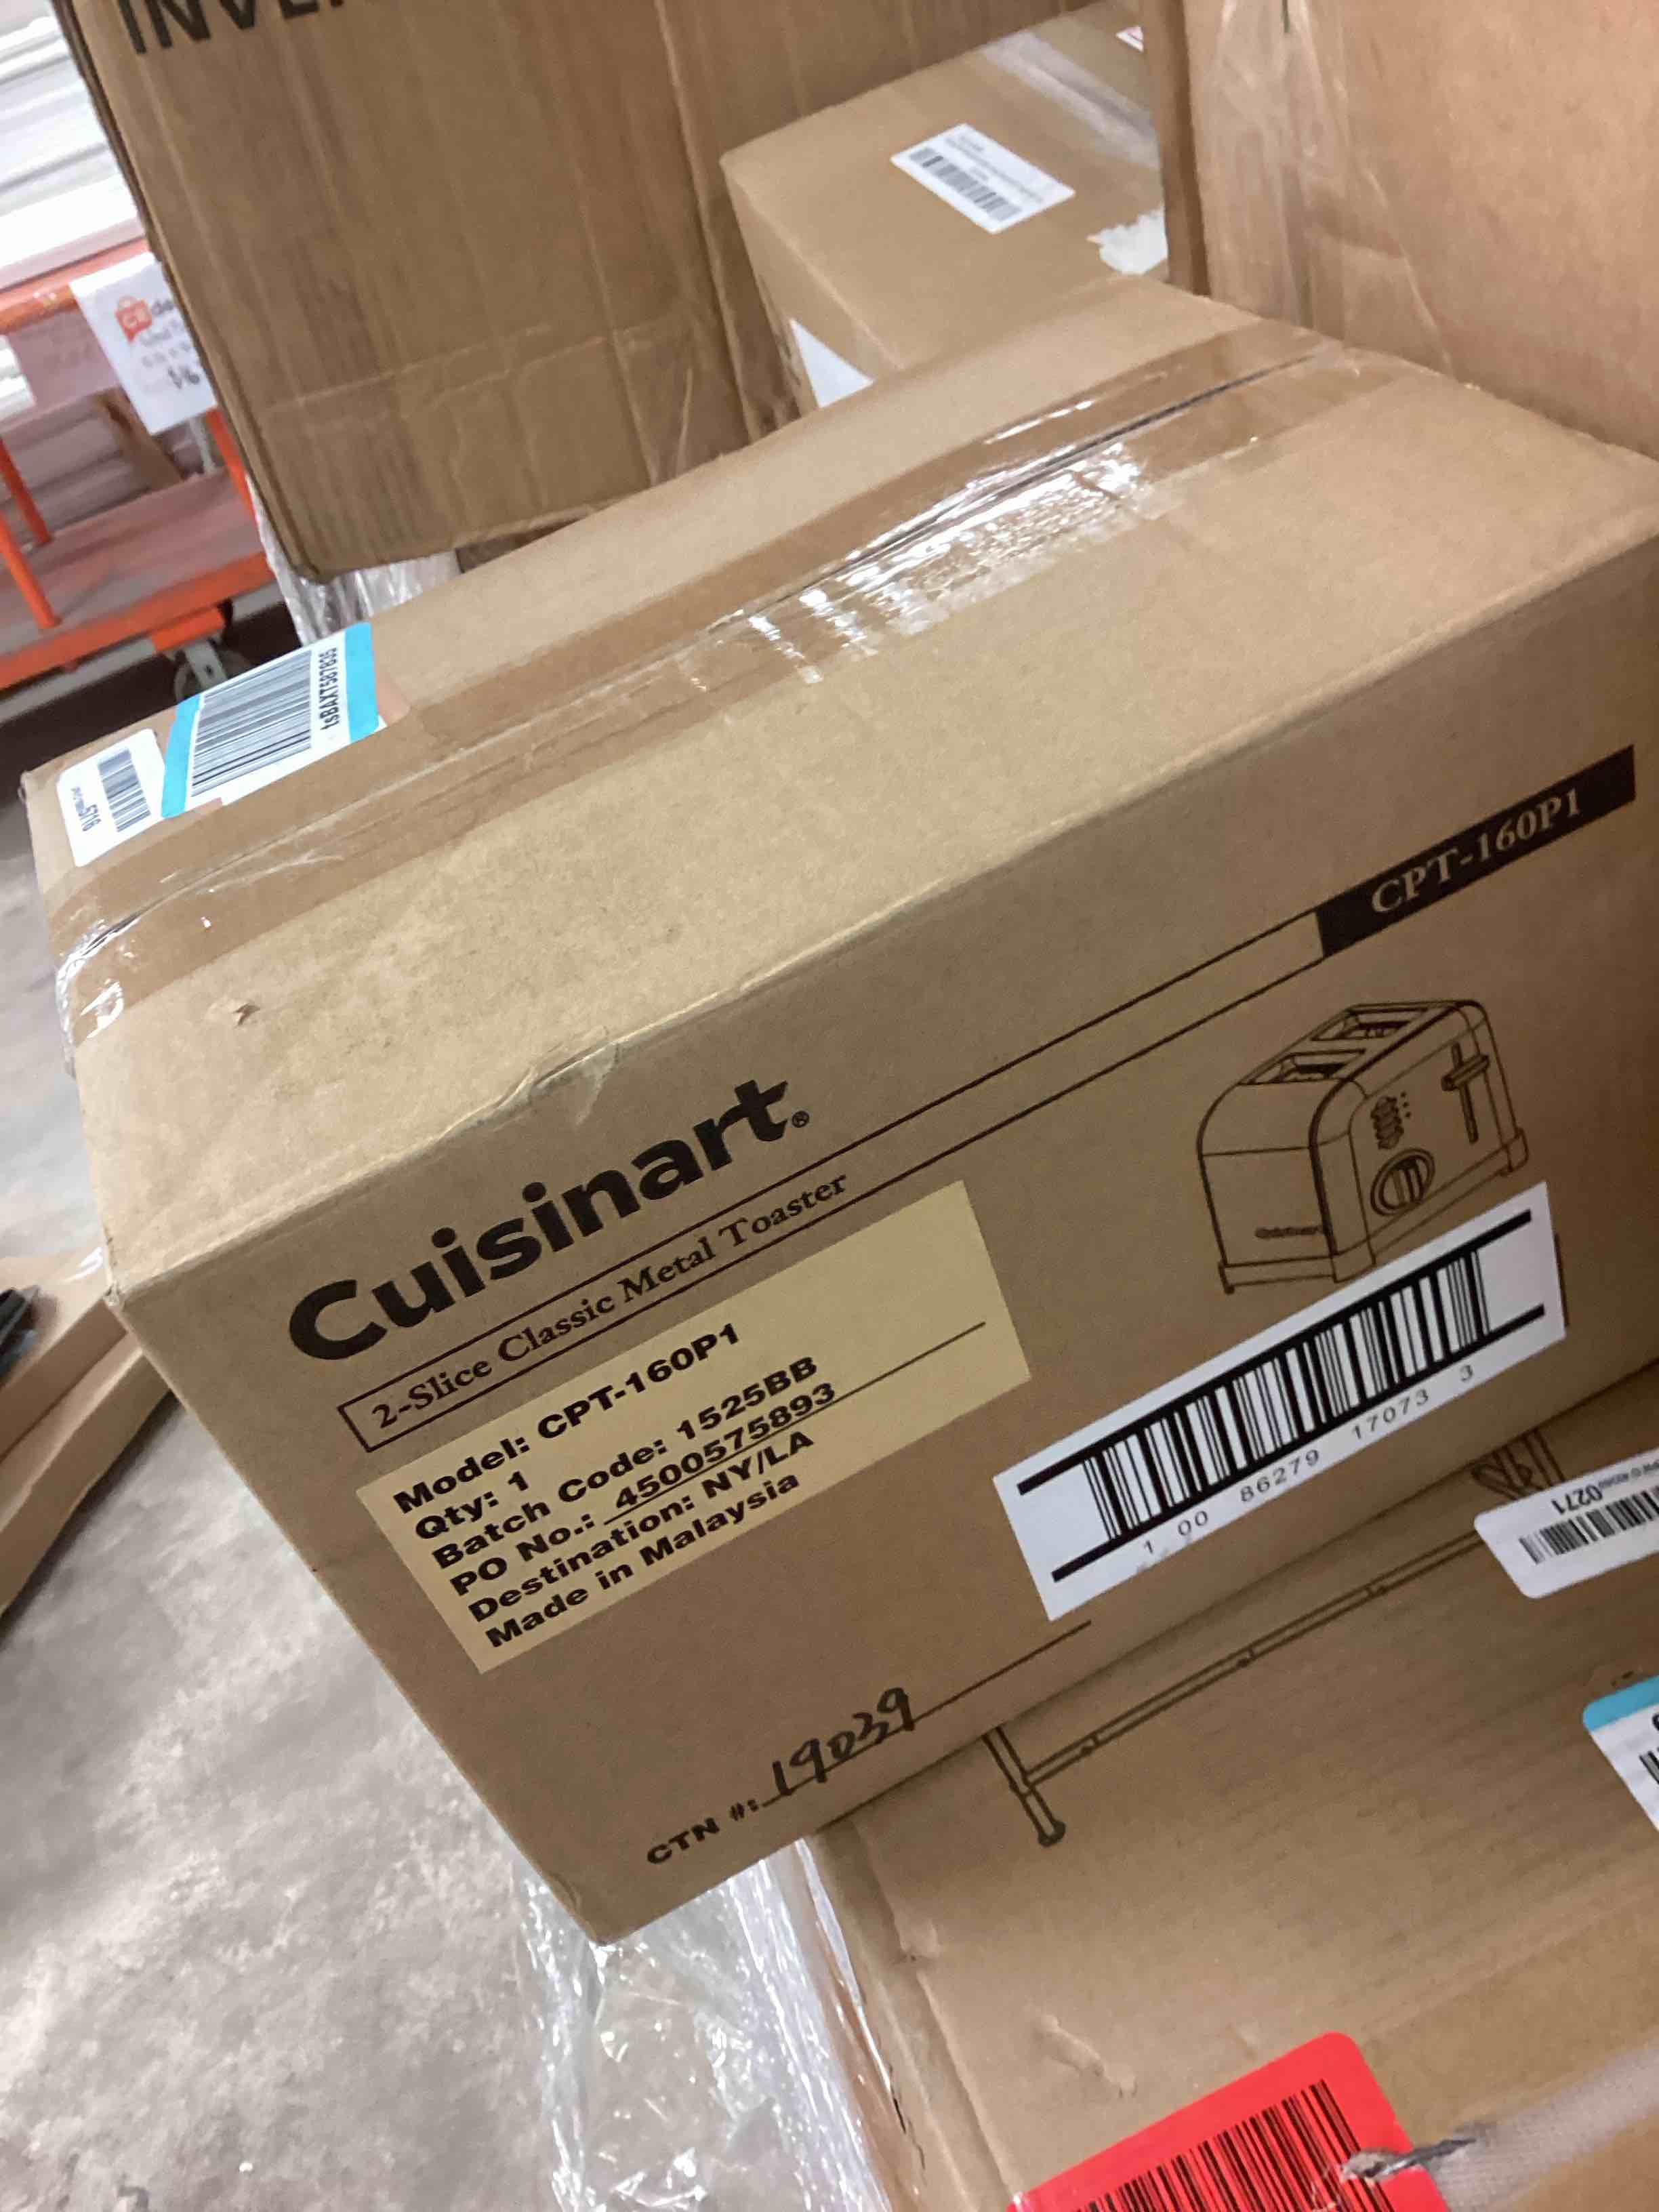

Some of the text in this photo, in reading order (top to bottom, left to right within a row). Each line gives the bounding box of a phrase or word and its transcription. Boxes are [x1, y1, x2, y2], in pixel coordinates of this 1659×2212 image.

[1372, 788, 1580, 914] CPT-160P1
[372, 1174, 846, 1429] 2-Slice Classic Metal Toaster
[393, 1324, 739, 1513] Model: CPT-160P1
[415, 1471, 529, 1539] Qty: 1
[432, 1357, 817, 1569] Batch Code: 1525BB
[450, 1382, 835, 1596] PO No.: 4500575893
[1144, 1364, 1474, 1555] 1 00 86279 17073 3
[1551, 1484, 1603, 1514] 0271
[468, 1431, 814, 1622] Destination: NY/LA
[485, 1475, 800, 1647] Made in Malaysia
[772, 1687, 915, 1797] 19039
[647, 1817, 720, 1864] CTN
